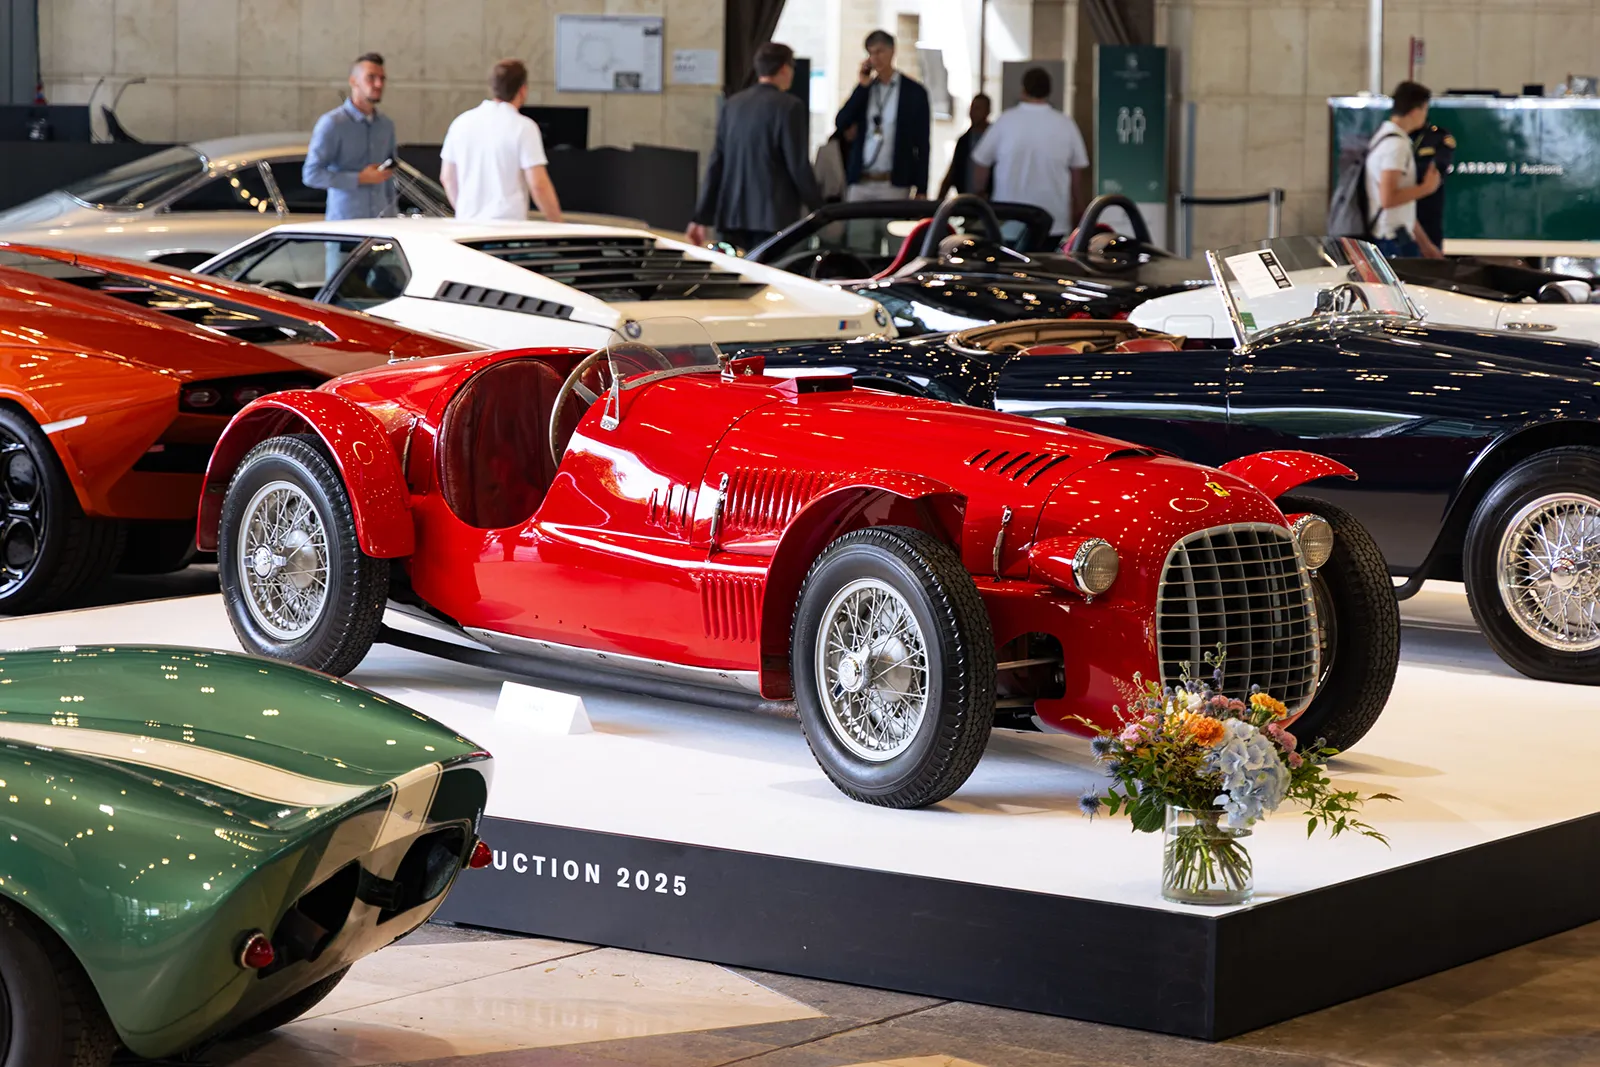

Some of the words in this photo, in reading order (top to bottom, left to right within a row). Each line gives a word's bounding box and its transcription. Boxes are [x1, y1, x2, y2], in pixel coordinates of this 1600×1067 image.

[1458, 161, 1507, 174] ARROW
[485, 849, 600, 884] UCTION
[616, 867, 687, 896] 2025
